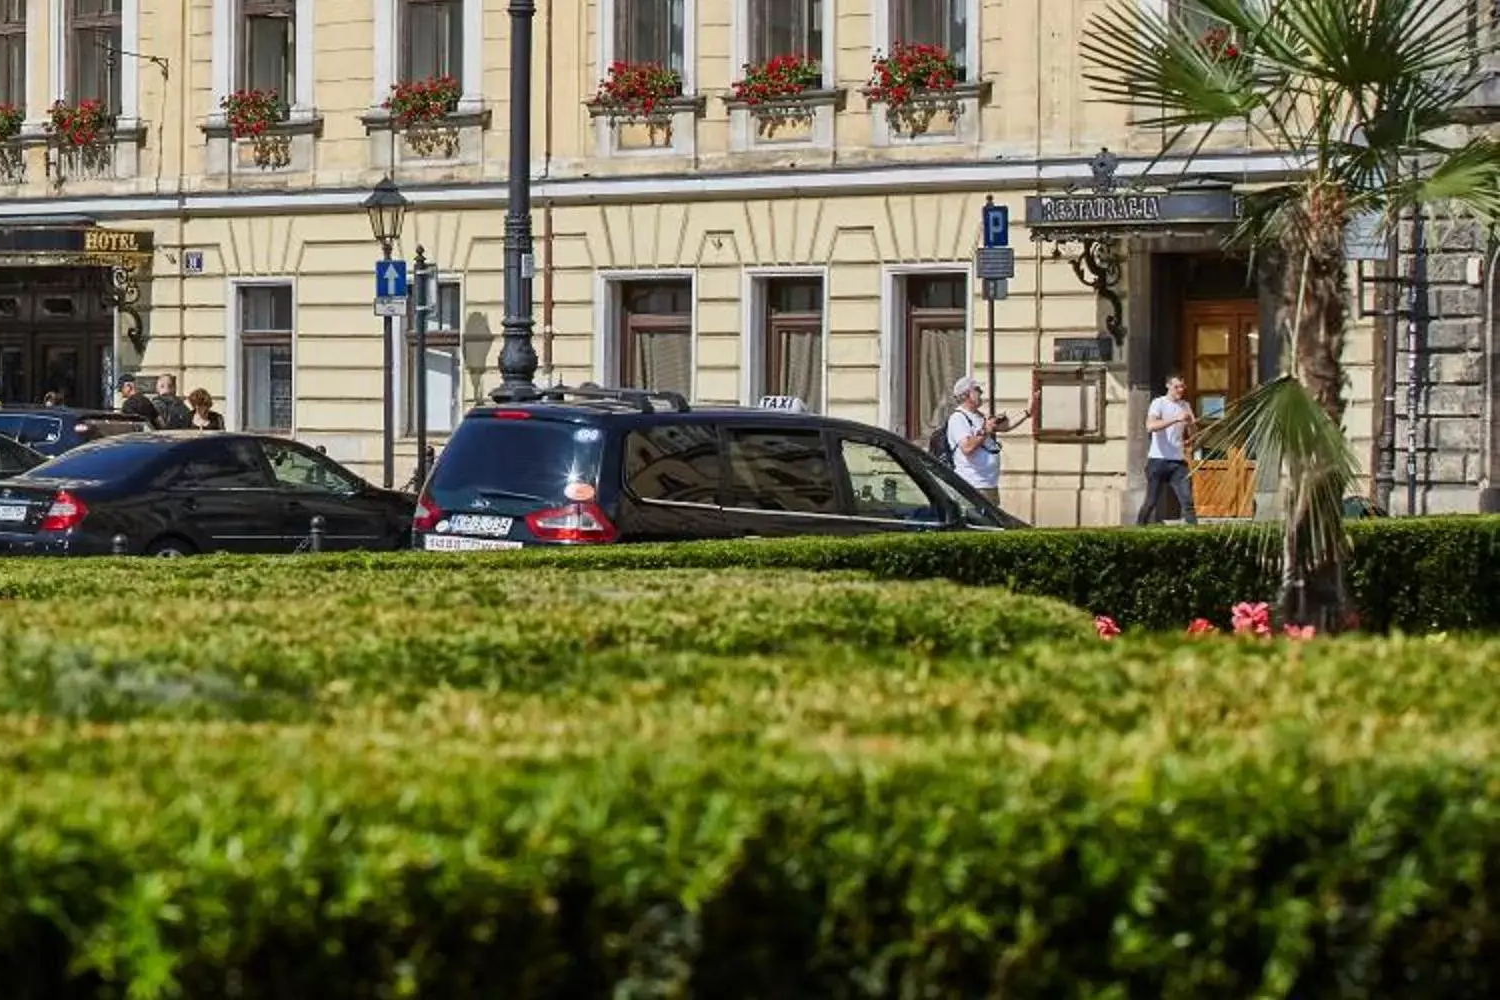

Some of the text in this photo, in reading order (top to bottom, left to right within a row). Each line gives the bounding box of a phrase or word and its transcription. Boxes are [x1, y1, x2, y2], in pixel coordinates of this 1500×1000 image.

[989, 210, 1002, 242] P
[85, 231, 139, 251] HOTEL
[763, 397, 794, 409] TAXI
